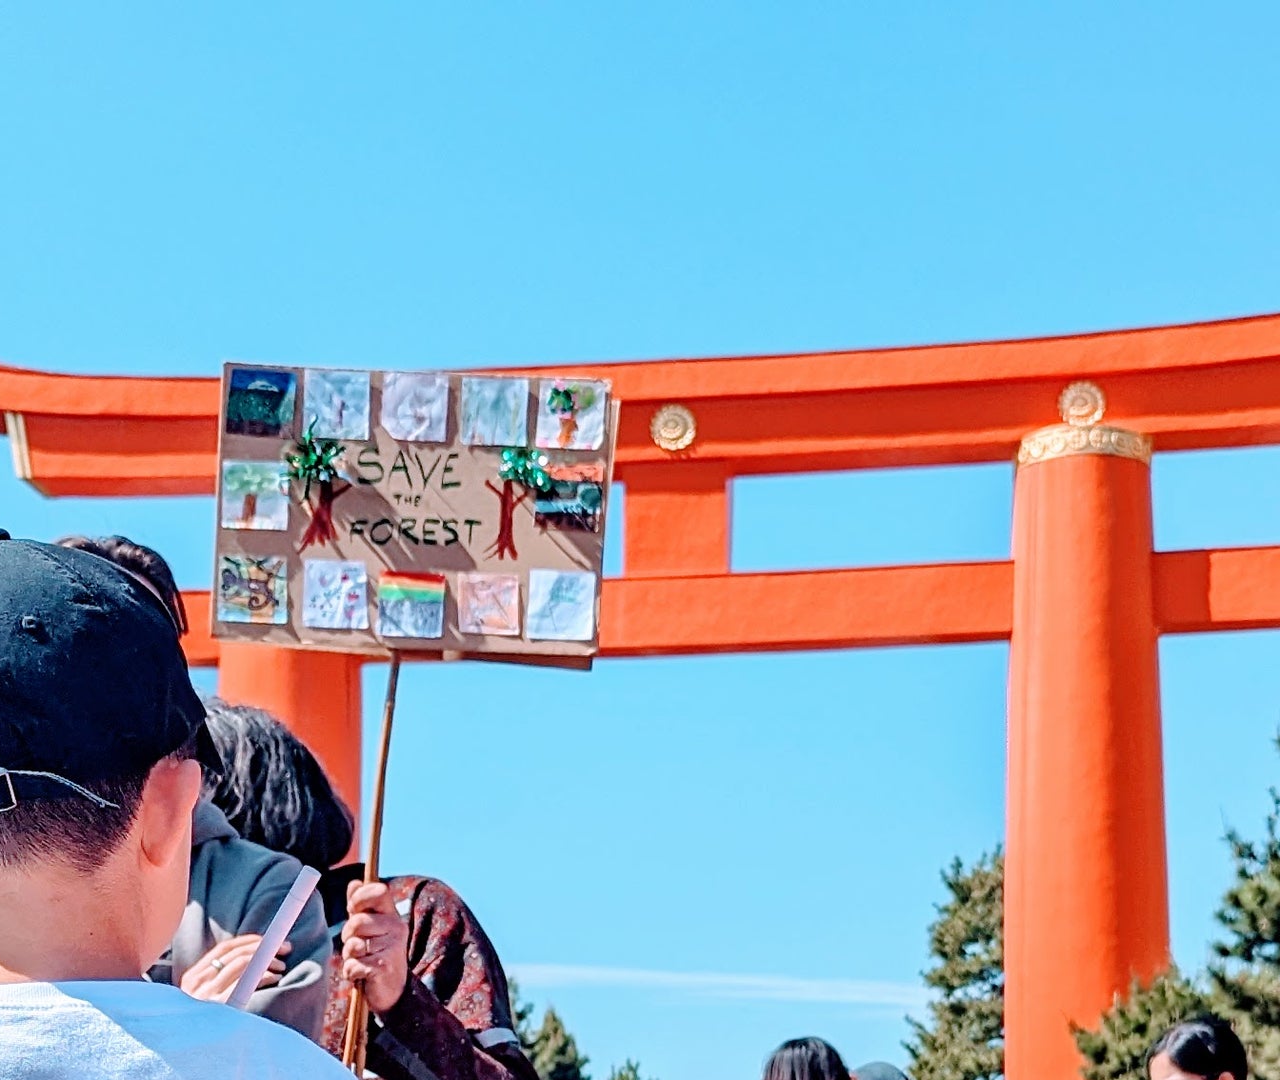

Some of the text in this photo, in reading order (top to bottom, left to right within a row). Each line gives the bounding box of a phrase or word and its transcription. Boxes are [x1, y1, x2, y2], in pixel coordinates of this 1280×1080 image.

[357, 447, 461, 490] SAVE
[393, 493, 421, 507] THE
[350, 518, 481, 546] FOREST
